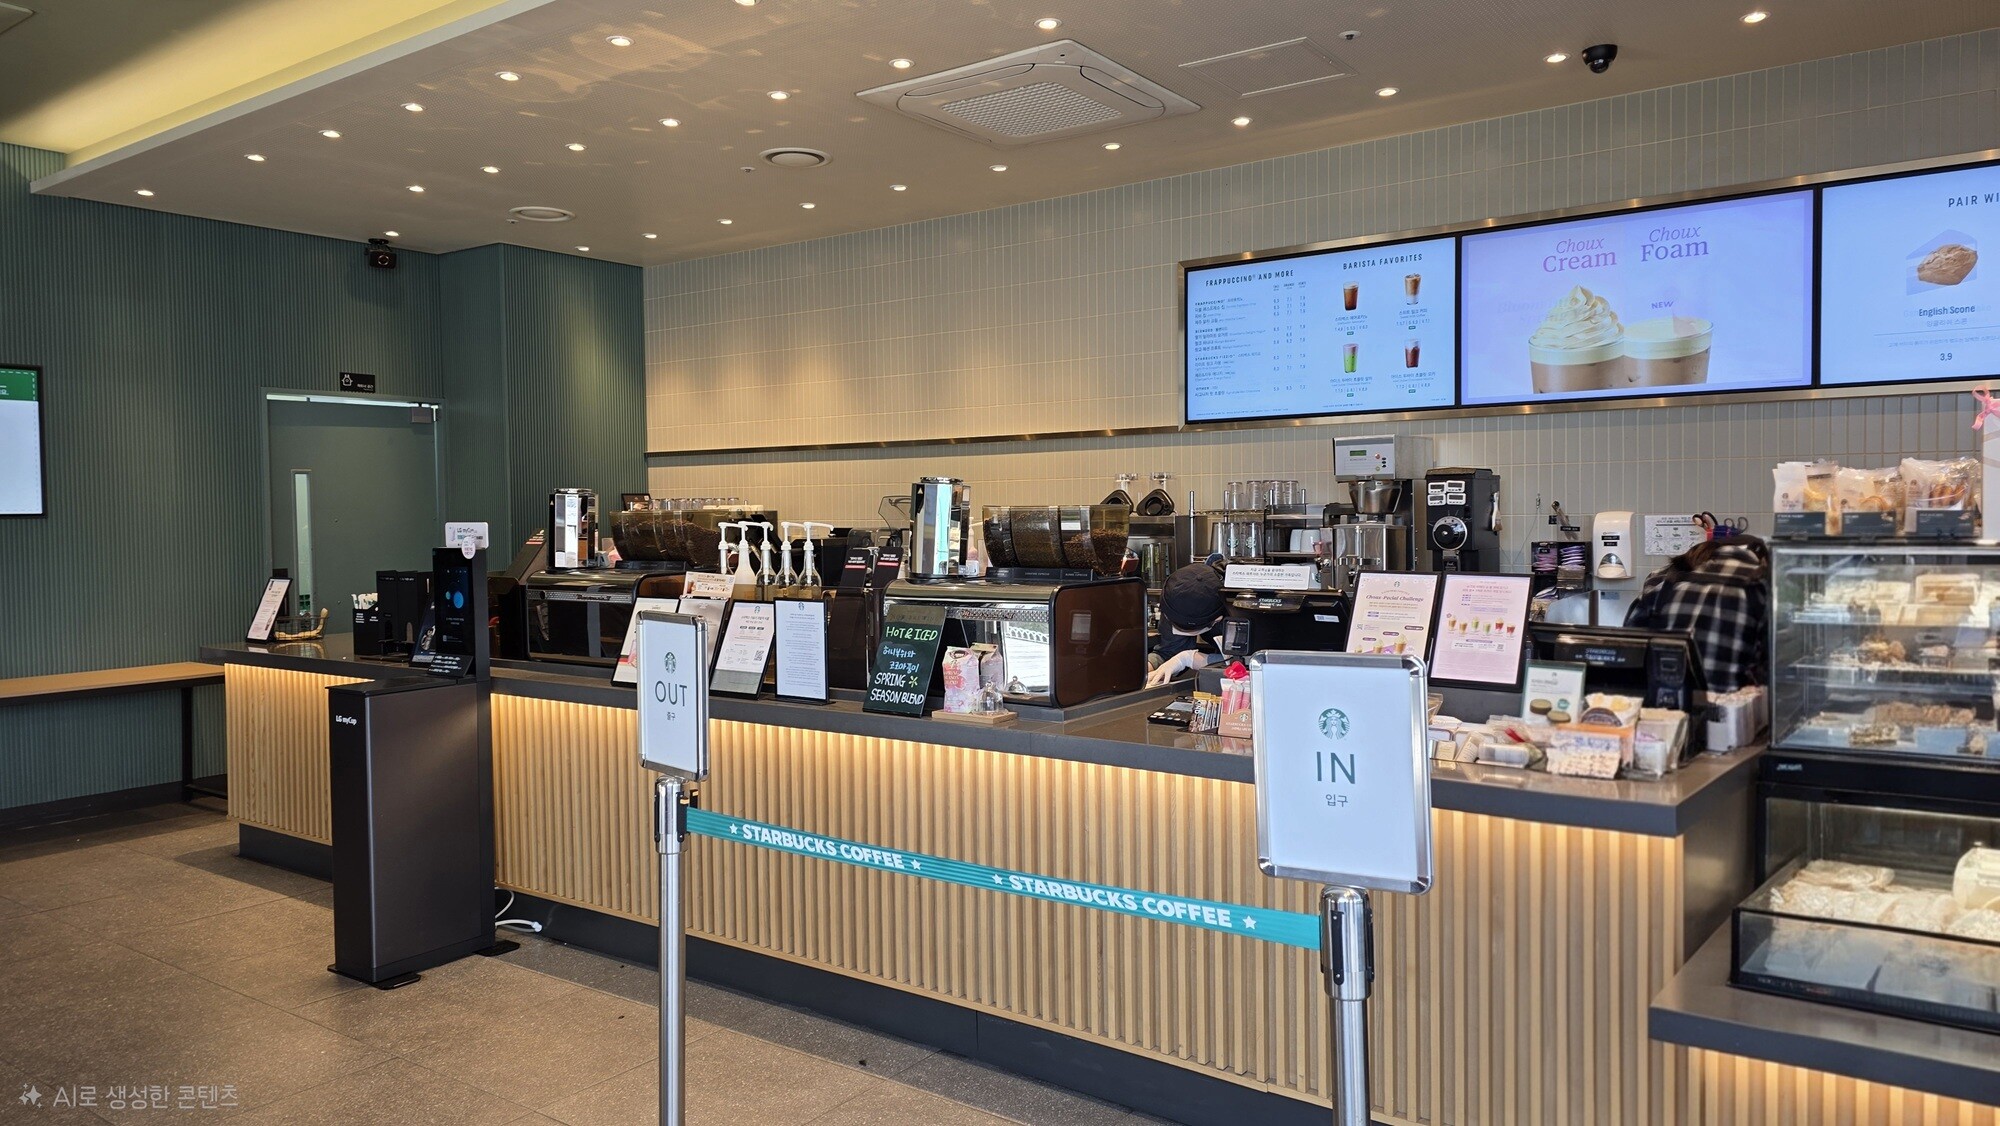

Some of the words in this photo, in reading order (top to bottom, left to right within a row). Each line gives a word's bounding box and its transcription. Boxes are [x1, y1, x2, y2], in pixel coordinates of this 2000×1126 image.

[1948, 195, 1978, 208] PAIR
[1649, 226, 1701, 243] Choux
[1556, 237, 1605, 254] Choux
[1641, 240, 1709, 262] Foam
[1343, 260, 1376, 270] BARISTA
[1380, 253, 1423, 265] FAVORITES
[1542, 251, 1617, 273] Cream
[1258, 272, 1272, 280] AND
[1275, 269, 1294, 278] MORE
[1651, 300, 1674, 310] NEW
[1918, 306, 1949, 318] English
[1949, 304, 1976, 315] Scone
[1955, 317, 1968, 325] 스콘
[905, 627, 913, 639] &
[914, 628, 938, 641] ICED
[874, 672, 906, 688] SPRING
[655, 681, 687, 707] OUT
[870, 688, 901, 704] SEASON
[901, 691, 925, 705] BLEND
[1316, 751, 1357, 785] IN
[1325, 793, 1349, 808] 입구
[742, 824, 838, 858] STARBUCKS
[839, 841, 906, 871] COFFEE
[1007, 873, 1138, 913] STARBUCKS
[1142, 896, 1233, 929] COFFEE
